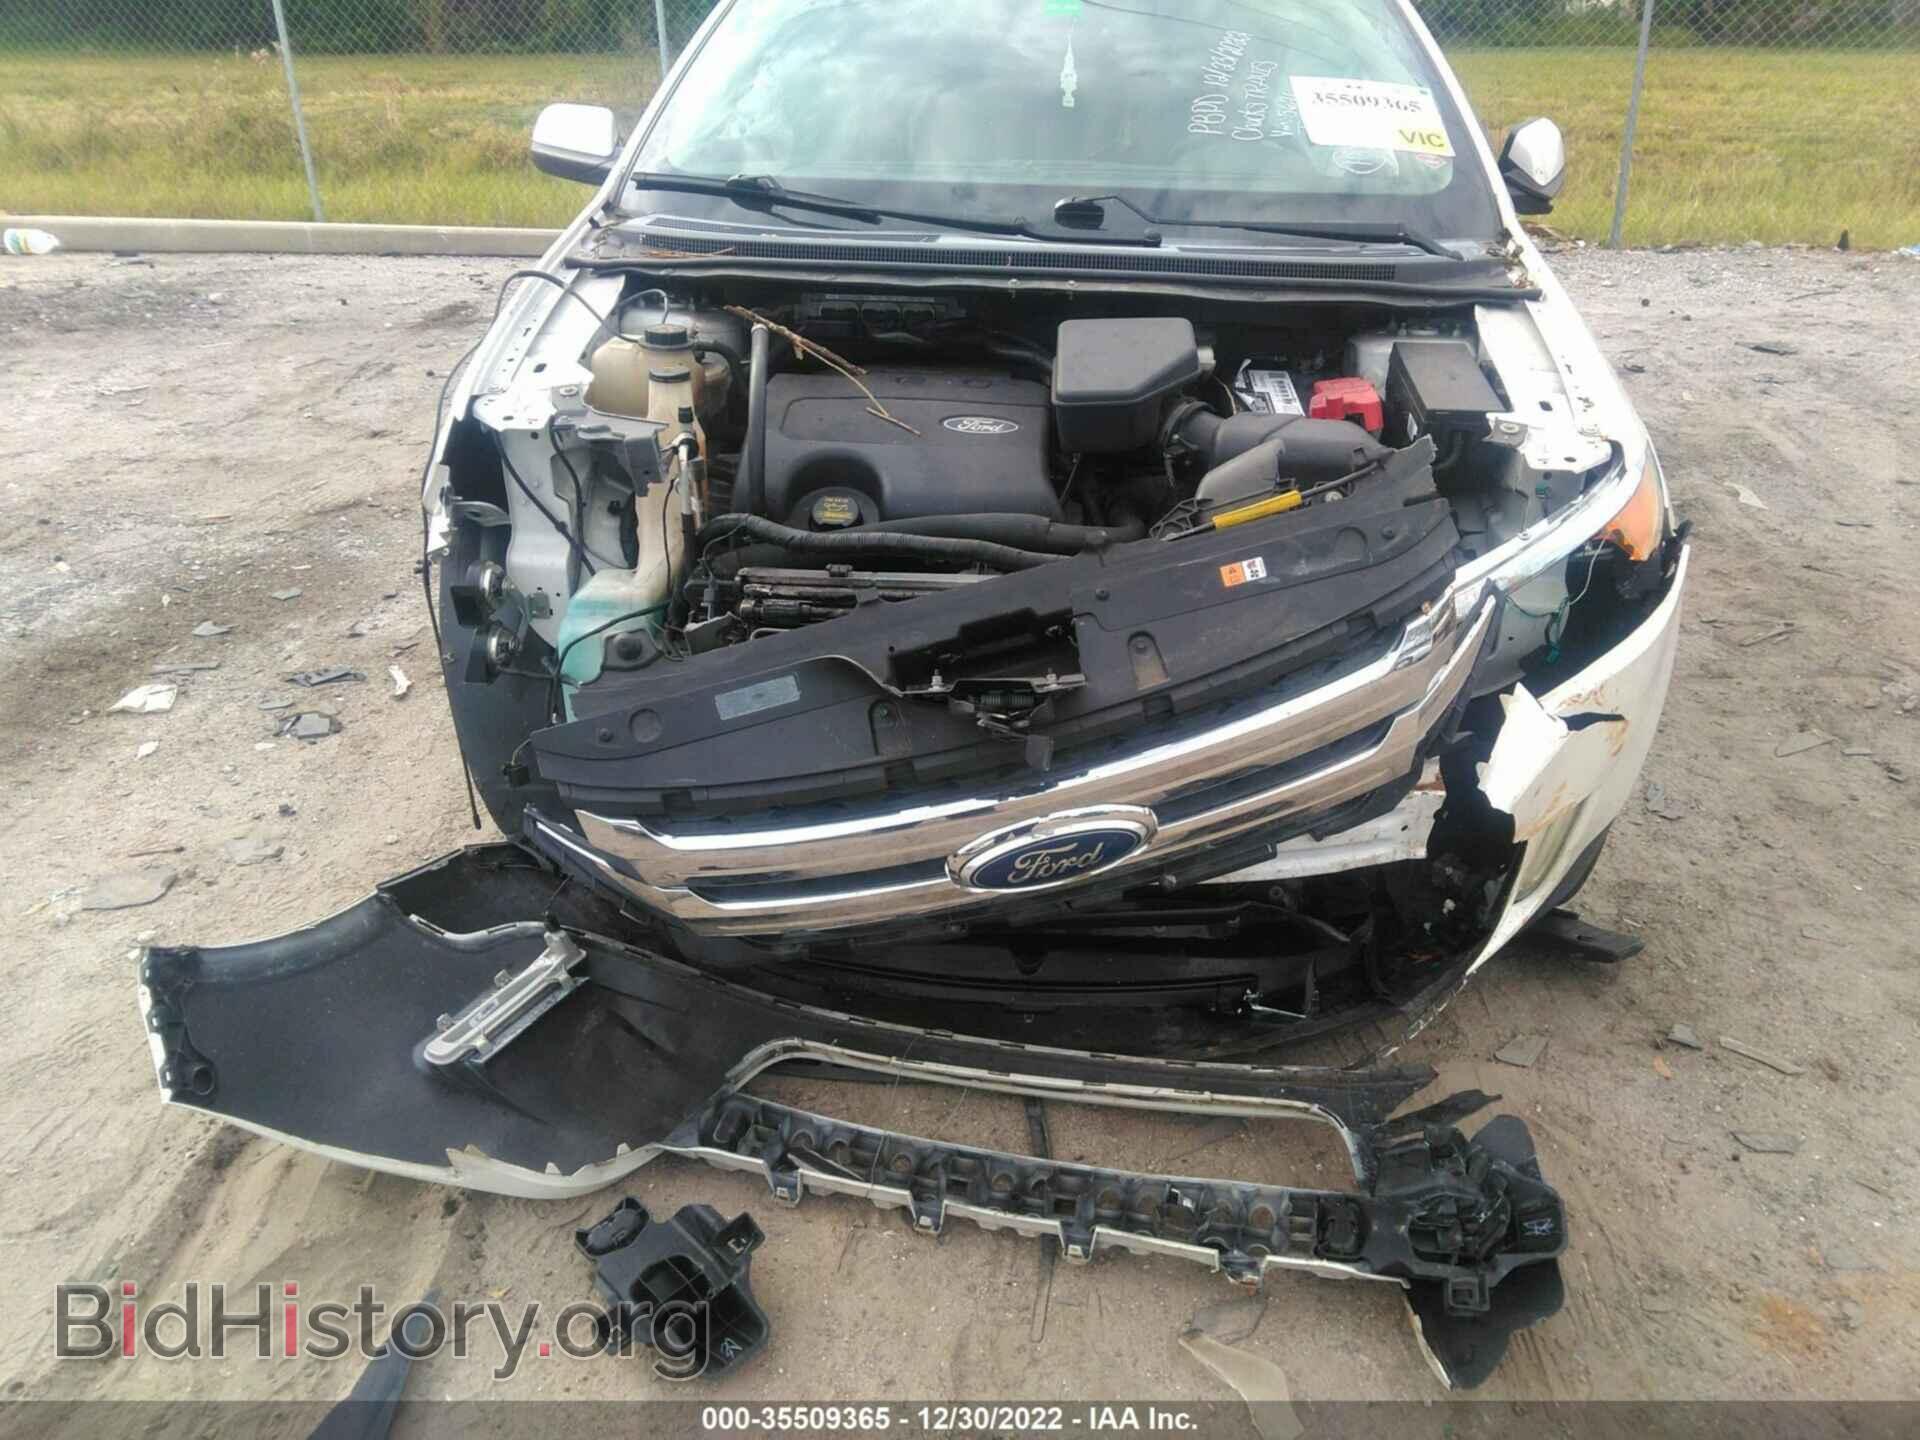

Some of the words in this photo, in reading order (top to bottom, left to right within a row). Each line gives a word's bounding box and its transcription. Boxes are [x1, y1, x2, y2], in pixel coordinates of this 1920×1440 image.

[1399, 129, 1446, 149] VIC
[957, 418, 1006, 433] Ford
[1007, 841, 1105, 884] Ford
